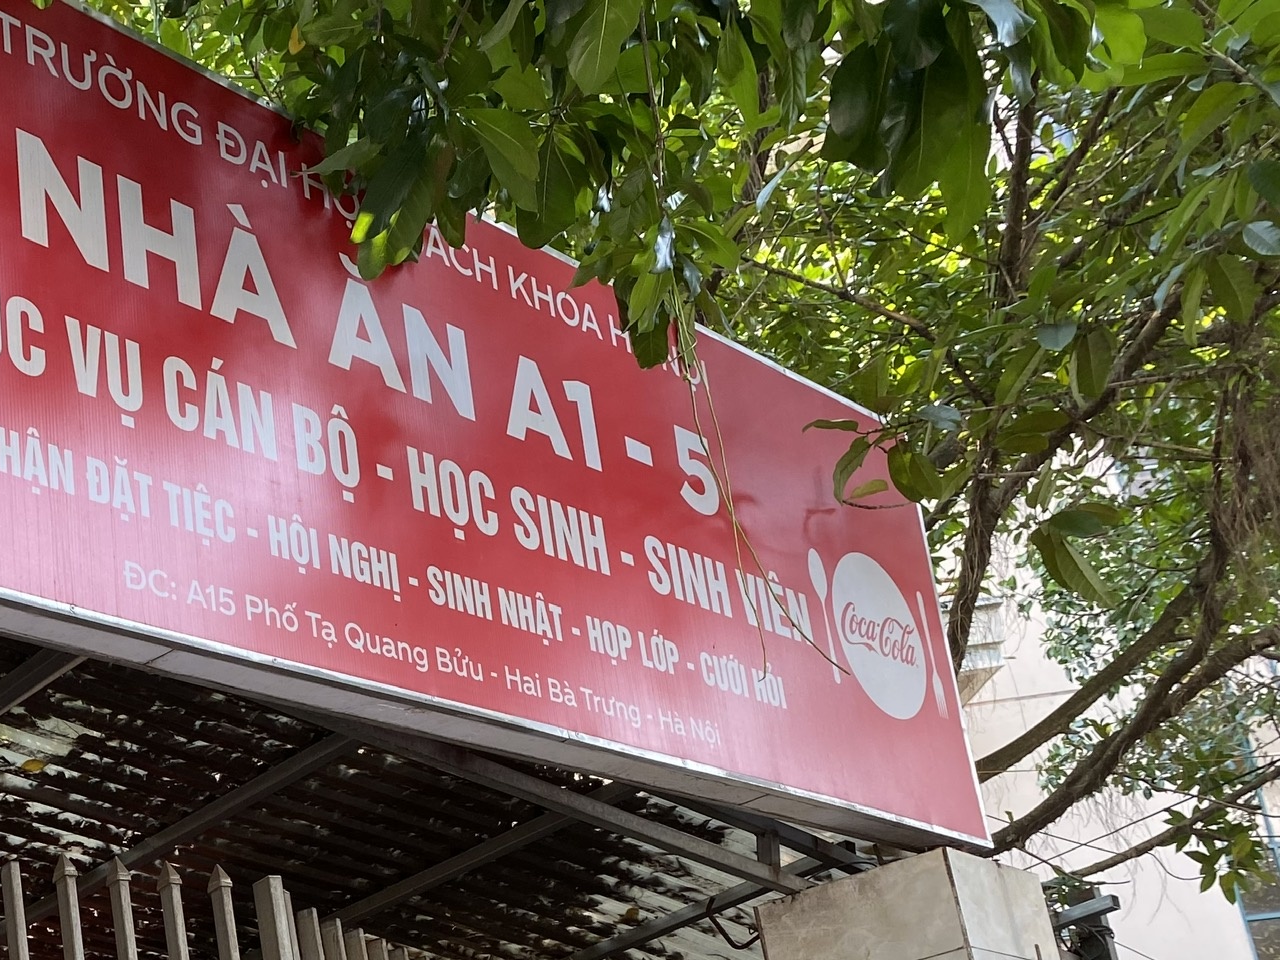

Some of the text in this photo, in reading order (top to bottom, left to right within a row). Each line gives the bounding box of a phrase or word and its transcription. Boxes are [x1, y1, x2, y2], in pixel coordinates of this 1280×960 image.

[16, 127, 297, 349] NHÀ
[506, 355, 603, 472] A1
[625, 436, 653, 467] -
[673, 425, 720, 516] 5
[216, 121, 288, 189] ĐẠI
[508, 264, 603, 341] KHOA
[64, 315, 143, 429] VỤ
[163, 356, 278, 461] CÁN
[291, 403, 361, 503] BỘ
[376, 463, 394, 481] -
[406, 445, 499, 541] HỌC
[510, 486, 611, 576] SINH
[620, 551, 635, 566] -
[643, 535, 732, 618] SINH
[734, 570, 814, 647] VIÊN
[86, 455, 152, 522] ĐẶT
[162, 480, 236, 546] TIỆC
[267, 513, 321, 575] HỘI
[328, 533, 401, 602] NGHỊ
[427, 565, 493, 620] SINH
[497, 587, 563, 646] NHẬT
[585, 615, 632, 665] HỌP
[638, 628, 680, 675] LỚP
[700, 651, 749, 698] CƯỚI
[123, 559, 177, 600] ĐC:
[187, 580, 236, 616] A15
[245, 594, 299, 632] Phố
[305, 610, 337, 649] Tạ
[344, 622, 428, 672] Quang
[435, 646, 483, 681] Bửu
[504, 665, 542, 698] Hai
[548, 678, 577, 707] Bà
[580, 687, 641, 728] Trưng
[658, 707, 686, 736] Hà
[690, 717, 720, 749] Nội
[841, 602, 917, 668] Coca-Cola
